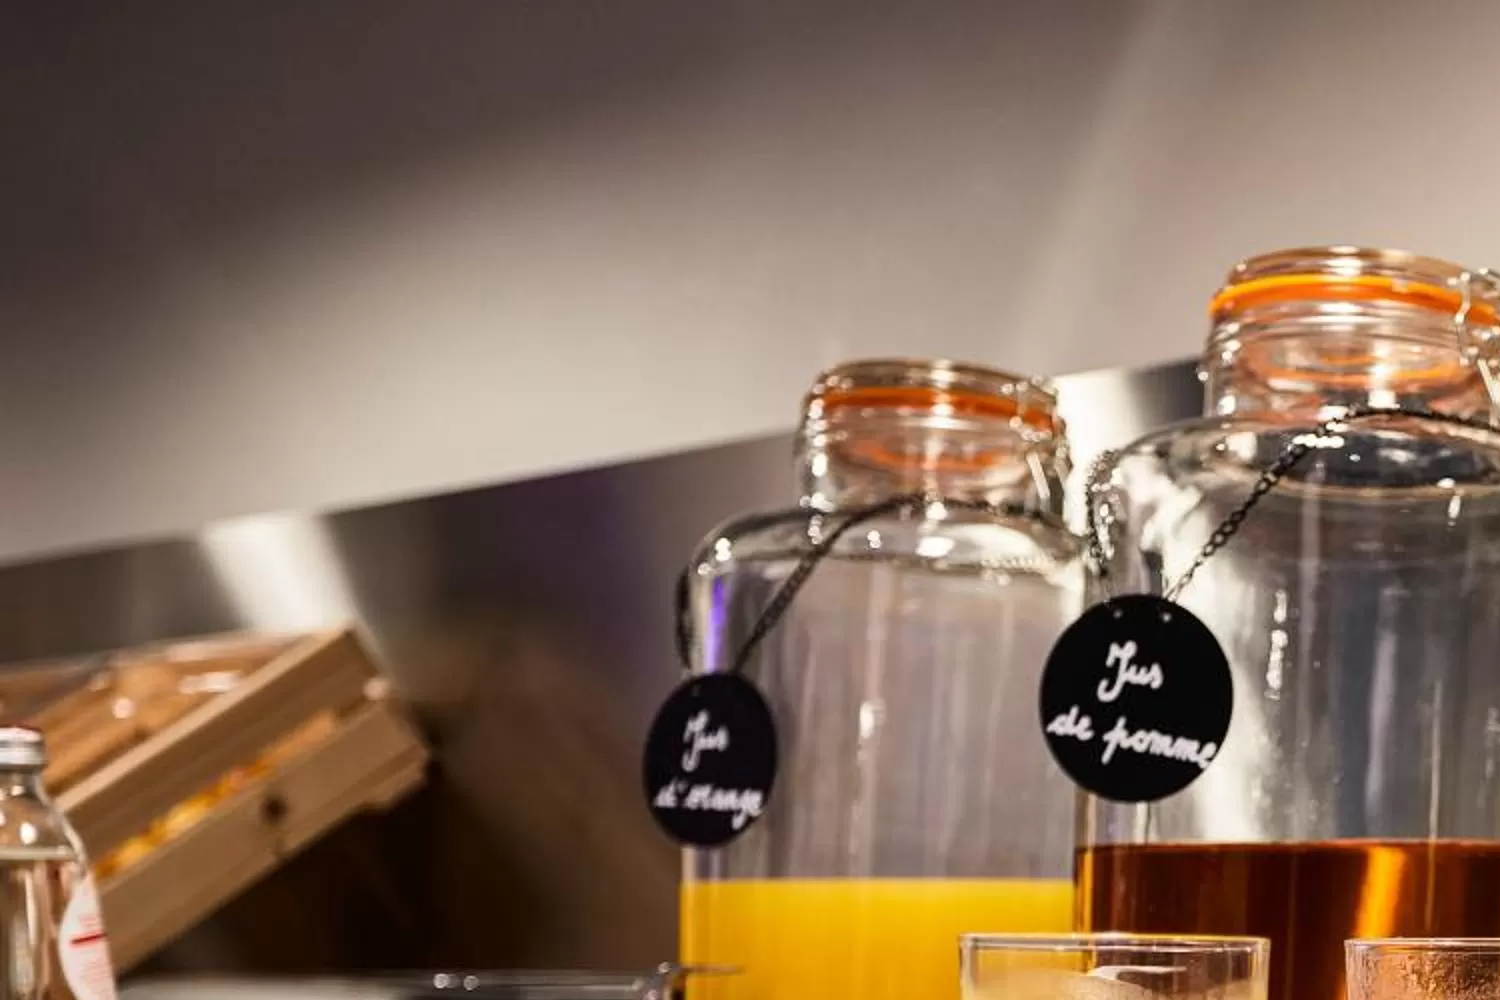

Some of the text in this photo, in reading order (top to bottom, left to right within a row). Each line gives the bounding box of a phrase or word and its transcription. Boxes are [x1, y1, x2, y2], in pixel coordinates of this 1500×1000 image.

[1097, 640, 1164, 702] Jus
[682, 709, 729, 772] Jus
[1046, 704, 1217, 769] de pomme
